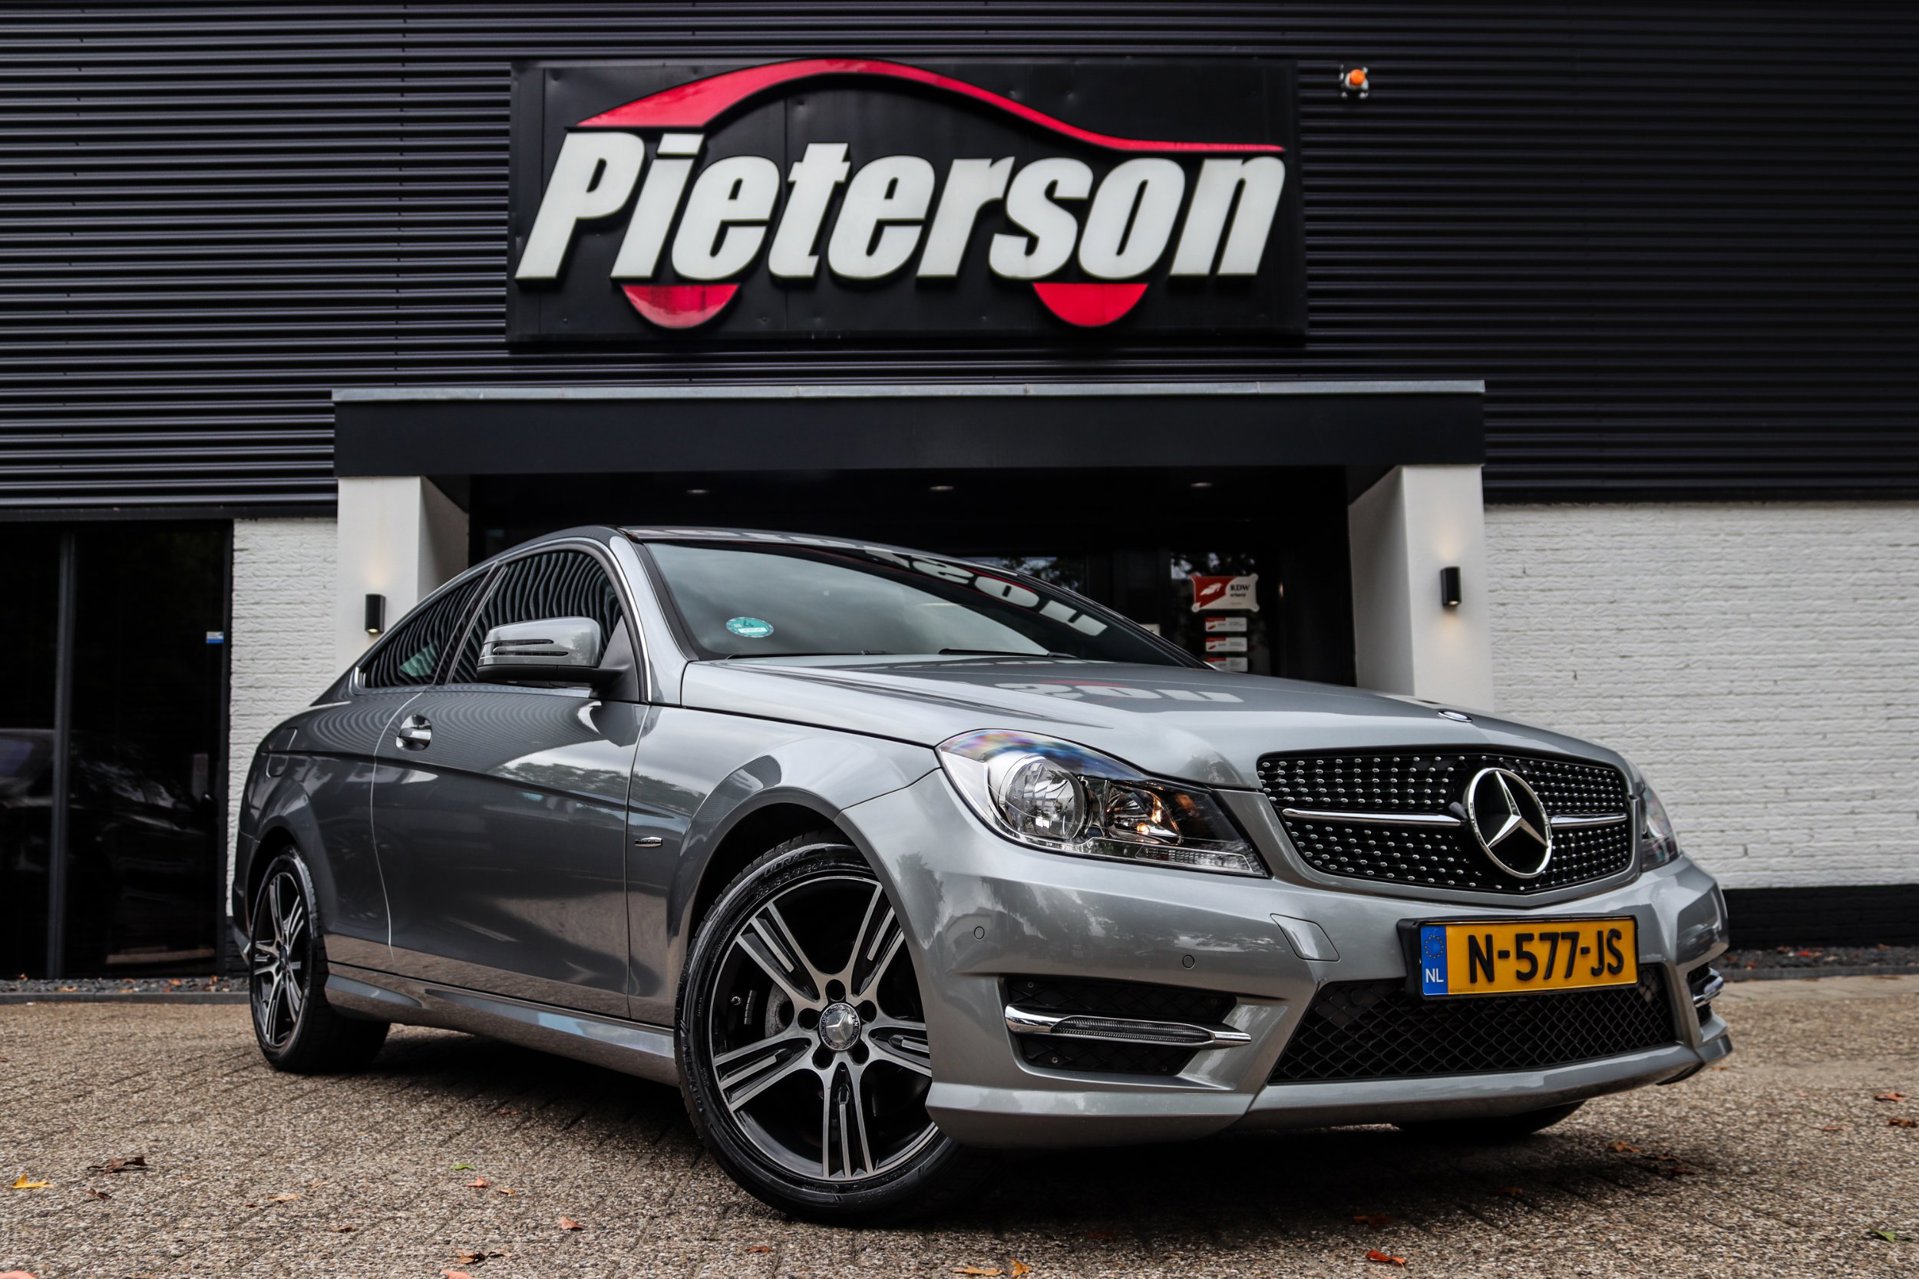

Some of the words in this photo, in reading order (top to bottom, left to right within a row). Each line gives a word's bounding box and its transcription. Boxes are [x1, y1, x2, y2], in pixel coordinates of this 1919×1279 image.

[514, 131, 1286, 280] Pieterson
[1425, 967, 1444, 984] NL
[1467, 928, 1625, 984] N-577-JS
